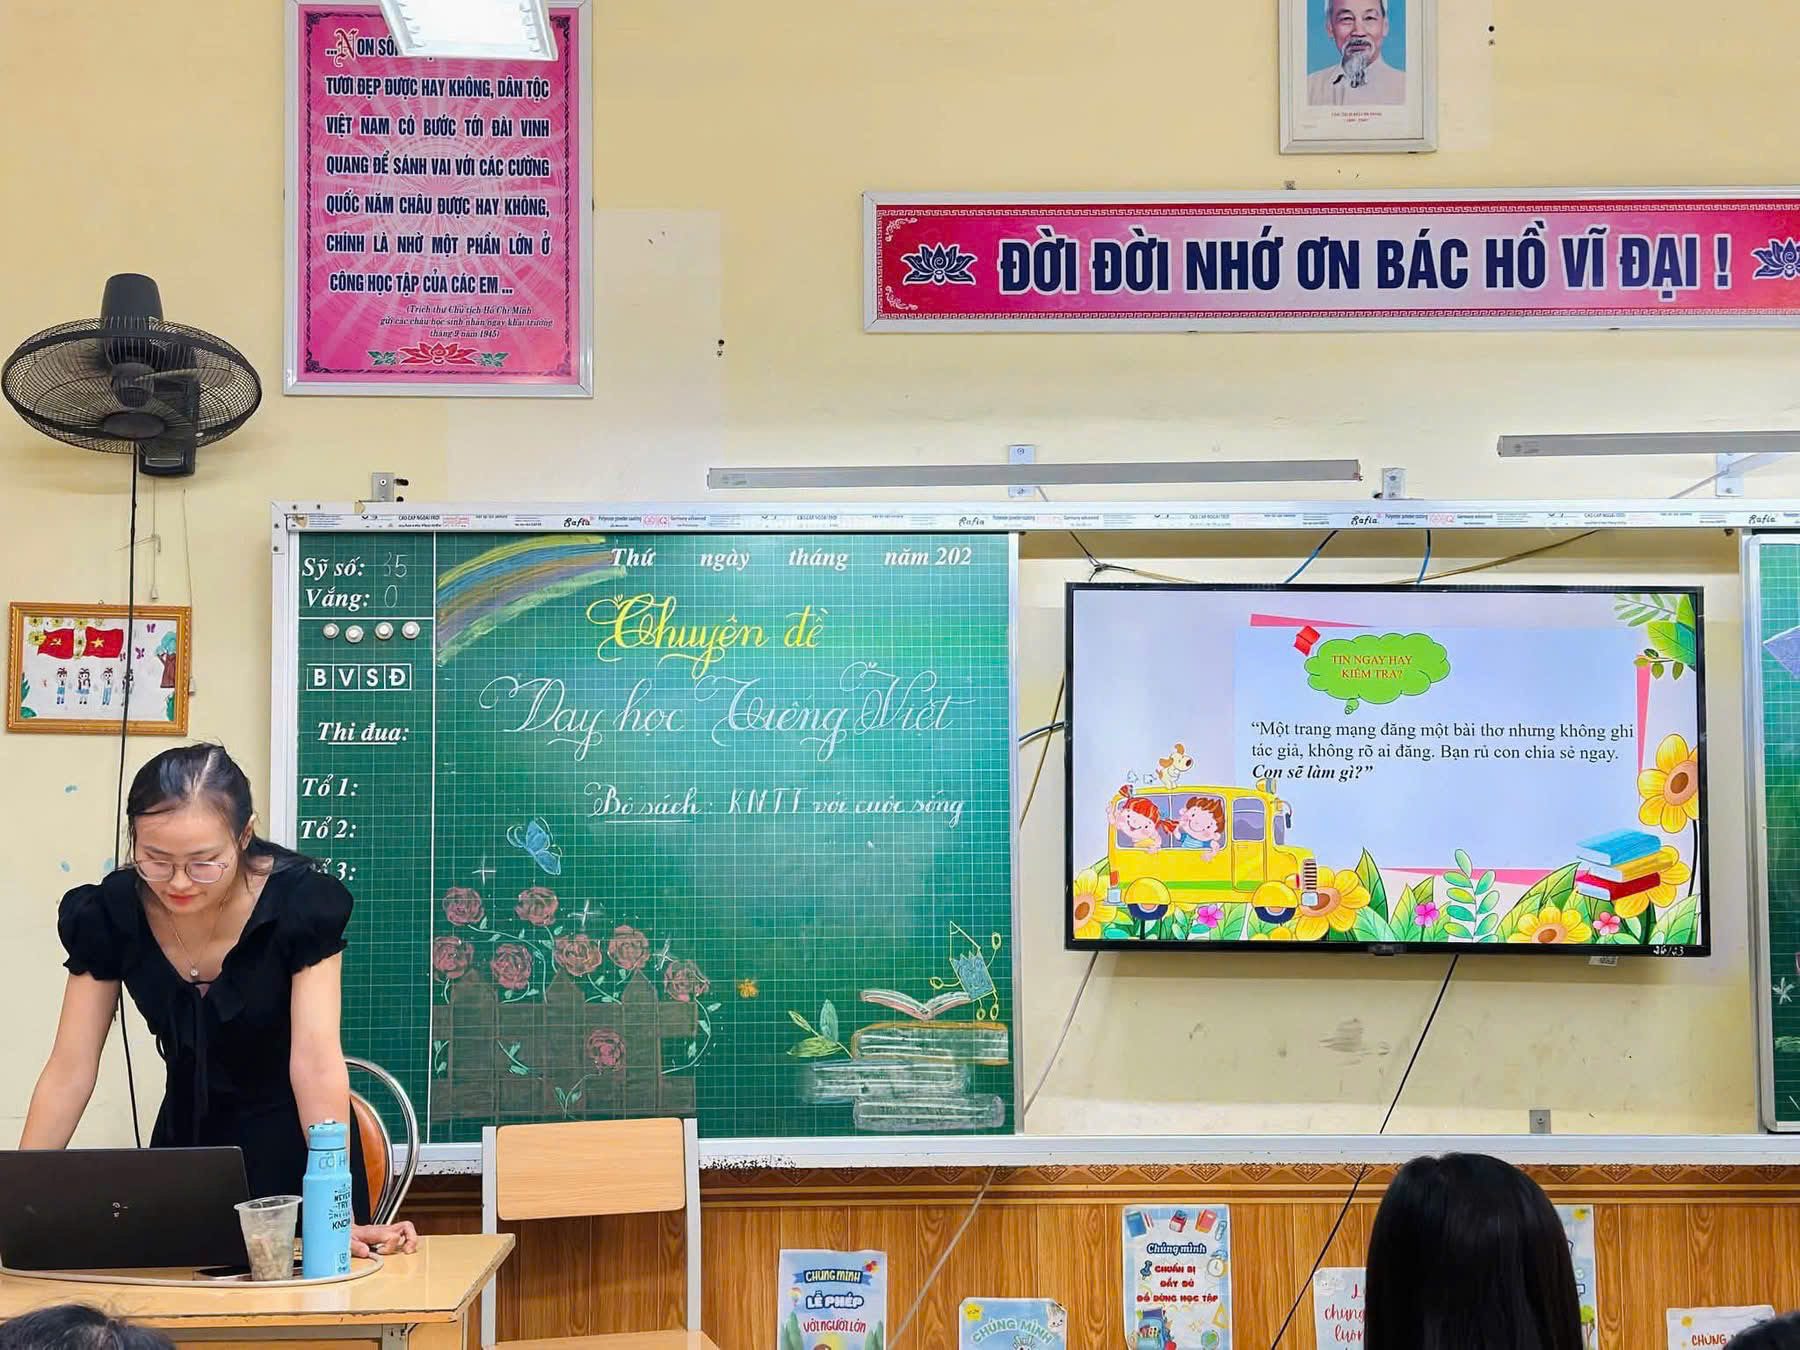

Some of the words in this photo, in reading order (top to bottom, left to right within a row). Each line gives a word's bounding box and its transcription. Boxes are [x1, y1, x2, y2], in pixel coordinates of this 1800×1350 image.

[326, 76, 353, 96] TƯƠI
[357, 77, 381, 99] ĐẸP
[384, 77, 418, 100] ĐƯỢC
[421, 79, 444, 97] HAY
[448, 76, 494, 98] KHÔNG,
[497, 76, 523, 97] DÂN
[526, 77, 549, 101] TỘC
[326, 115, 352, 138] VIỆT
[361, 117, 389, 134] NAM
[398, 114, 415, 135] CÓ
[423, 115, 456, 136] BƯỚC
[464, 115, 484, 136] TỚI
[492, 116, 513, 137] ĐÀI
[520, 119, 550, 137] VINH
[326, 156, 369, 175] QUANG
[372, 150, 389, 174] ĐỂ
[393, 154, 427, 175] SÁNH
[431, 158, 451, 176] VAI
[455, 154, 474, 176] VỚI
[479, 155, 504, 176] CÁC
[508, 155, 550, 177] CƯỜNG
[326, 190, 359, 215] QUỐC
[365, 193, 394, 214] NĂM
[399, 192, 432, 215] CHÂU
[437, 196, 470, 218] ĐƯỢC
[476, 198, 498, 215] HAY
[504, 193, 550, 218] KHÔNG,
[326, 231, 365, 253] CHÍNH
[373, 232, 389, 253] LÀ
[397, 231, 424, 254] NHỜ
[431, 234, 458, 257] MỘT
[466, 231, 500, 255] PHẦN
[509, 234, 533, 255] LỚN
[541, 233, 550, 255] Ở
[1000, 227, 1077, 292] ĐỜI
[1092, 227, 1169, 292] ĐỜI
[1187, 226, 1284, 291] NHỚ
[1298, 236, 1360, 290] ƠN
[1377, 228, 1468, 290] BÁC
[1486, 220, 1546, 289] HỒ
[1562, 227, 1608, 288] VĨ
[1619, 237, 1697, 299] ĐẠI
[330, 271, 364, 292] CÔNG
[367, 274, 392, 295] HỌC
[396, 272, 419, 296] TẬP
[423, 269, 448, 294] CỦA
[451, 272, 476, 294] CÁC
[302, 557, 328, 580] Sỹ
[334, 556, 365, 577] số:
[611, 547, 656, 567] Thứ
[700, 548, 750, 571] ngày
[789, 547, 849, 570] tháng
[885, 548, 929, 566] năm
[935, 547, 972, 566] 202
[304, 586, 370, 611] Vắng:
[586, 593, 770, 680] Chuyên
[783, 605, 829, 648] đề
[1331, 655, 1351, 665] TIN
[1354, 655, 1386, 665] NGAY
[1388, 655, 1413, 665] HAY
[612, 678, 686, 736] học
[694, 675, 848, 762] Tiếng
[840, 661, 977, 736] Việt
[317, 722, 355, 741] Thi
[361, 722, 409, 741] đua:
[1252, 721, 1290, 737] “Một
[1294, 724, 1331, 738] trang
[1336, 725, 1376, 739] mạng
[1380, 722, 1417, 740] đăng
[1421, 723, 1449, 739] một
[1454, 723, 1475, 737] bài
[1481, 723, 1505, 737] thơ
[1509, 723, 1555, 741] nhưng
[1560, 724, 1606, 741] không
[1611, 724, 1634, 742] ghi
[1252, 743, 1273, 757] tác
[1308, 743, 1354, 760] không
[1358, 745, 1373, 758] rõ
[1378, 744, 1391, 757] ai
[1395, 744, 1435, 761] đăng.
[1441, 745, 1469, 761] Bạn
[1474, 745, 1489, 759] rủ
[1494, 747, 1520, 759] con
[1525, 745, 1555, 759] chia
[1560, 745, 1576, 759] sẻ
[1580, 747, 1619, 763] ngay.
[1252, 764, 1283, 779] Con
[1287, 765, 1304, 779] sẽ
[1307, 765, 1335, 779] làm
[302, 773, 333, 797] Tổ
[337, 777, 358, 797] 1:
[300, 815, 332, 839] Tổ
[334, 819, 357, 838] 2:
[823, 1291, 864, 1309] PHÉP
